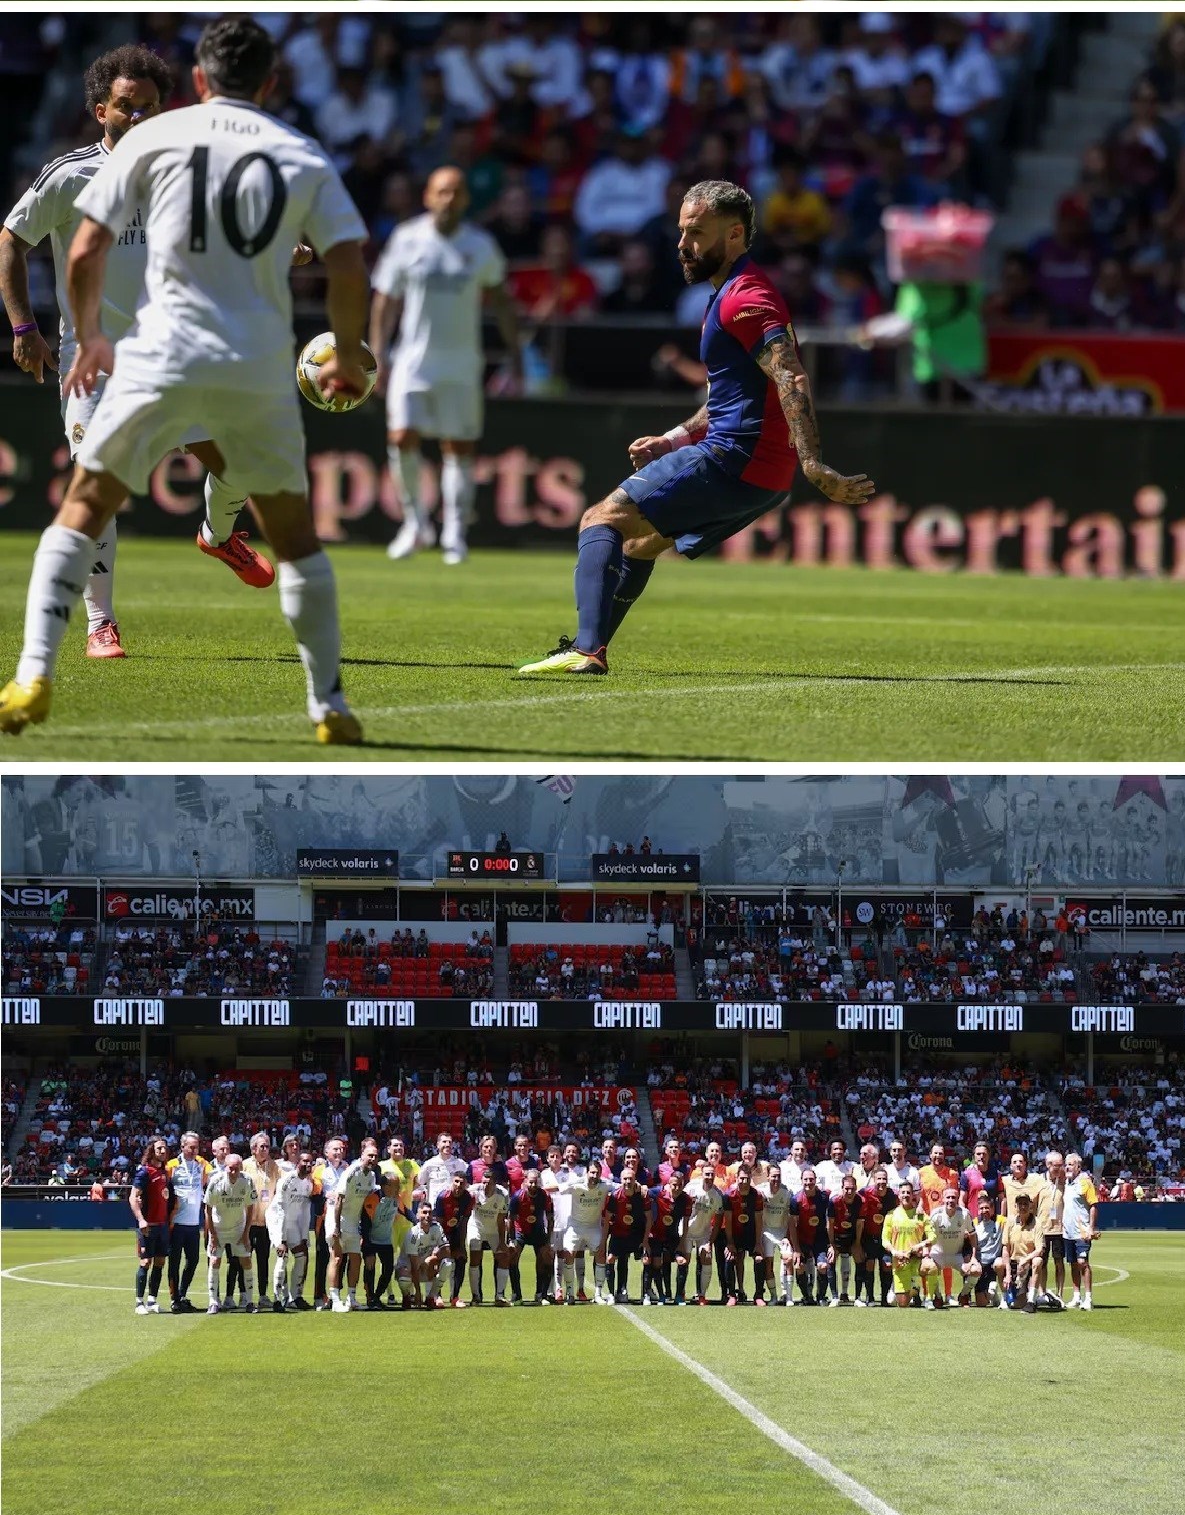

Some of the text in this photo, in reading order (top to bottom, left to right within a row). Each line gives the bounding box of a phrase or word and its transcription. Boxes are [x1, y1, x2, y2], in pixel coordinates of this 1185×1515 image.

[184, 145, 288, 259] 10
[299, 857, 379, 870] skydeck volaris
[470, 858, 479, 871] 0
[510, 858, 519, 871] 0
[599, 863, 678, 876] skydeck volaris
[908, 1034, 955, 1051] Corona
